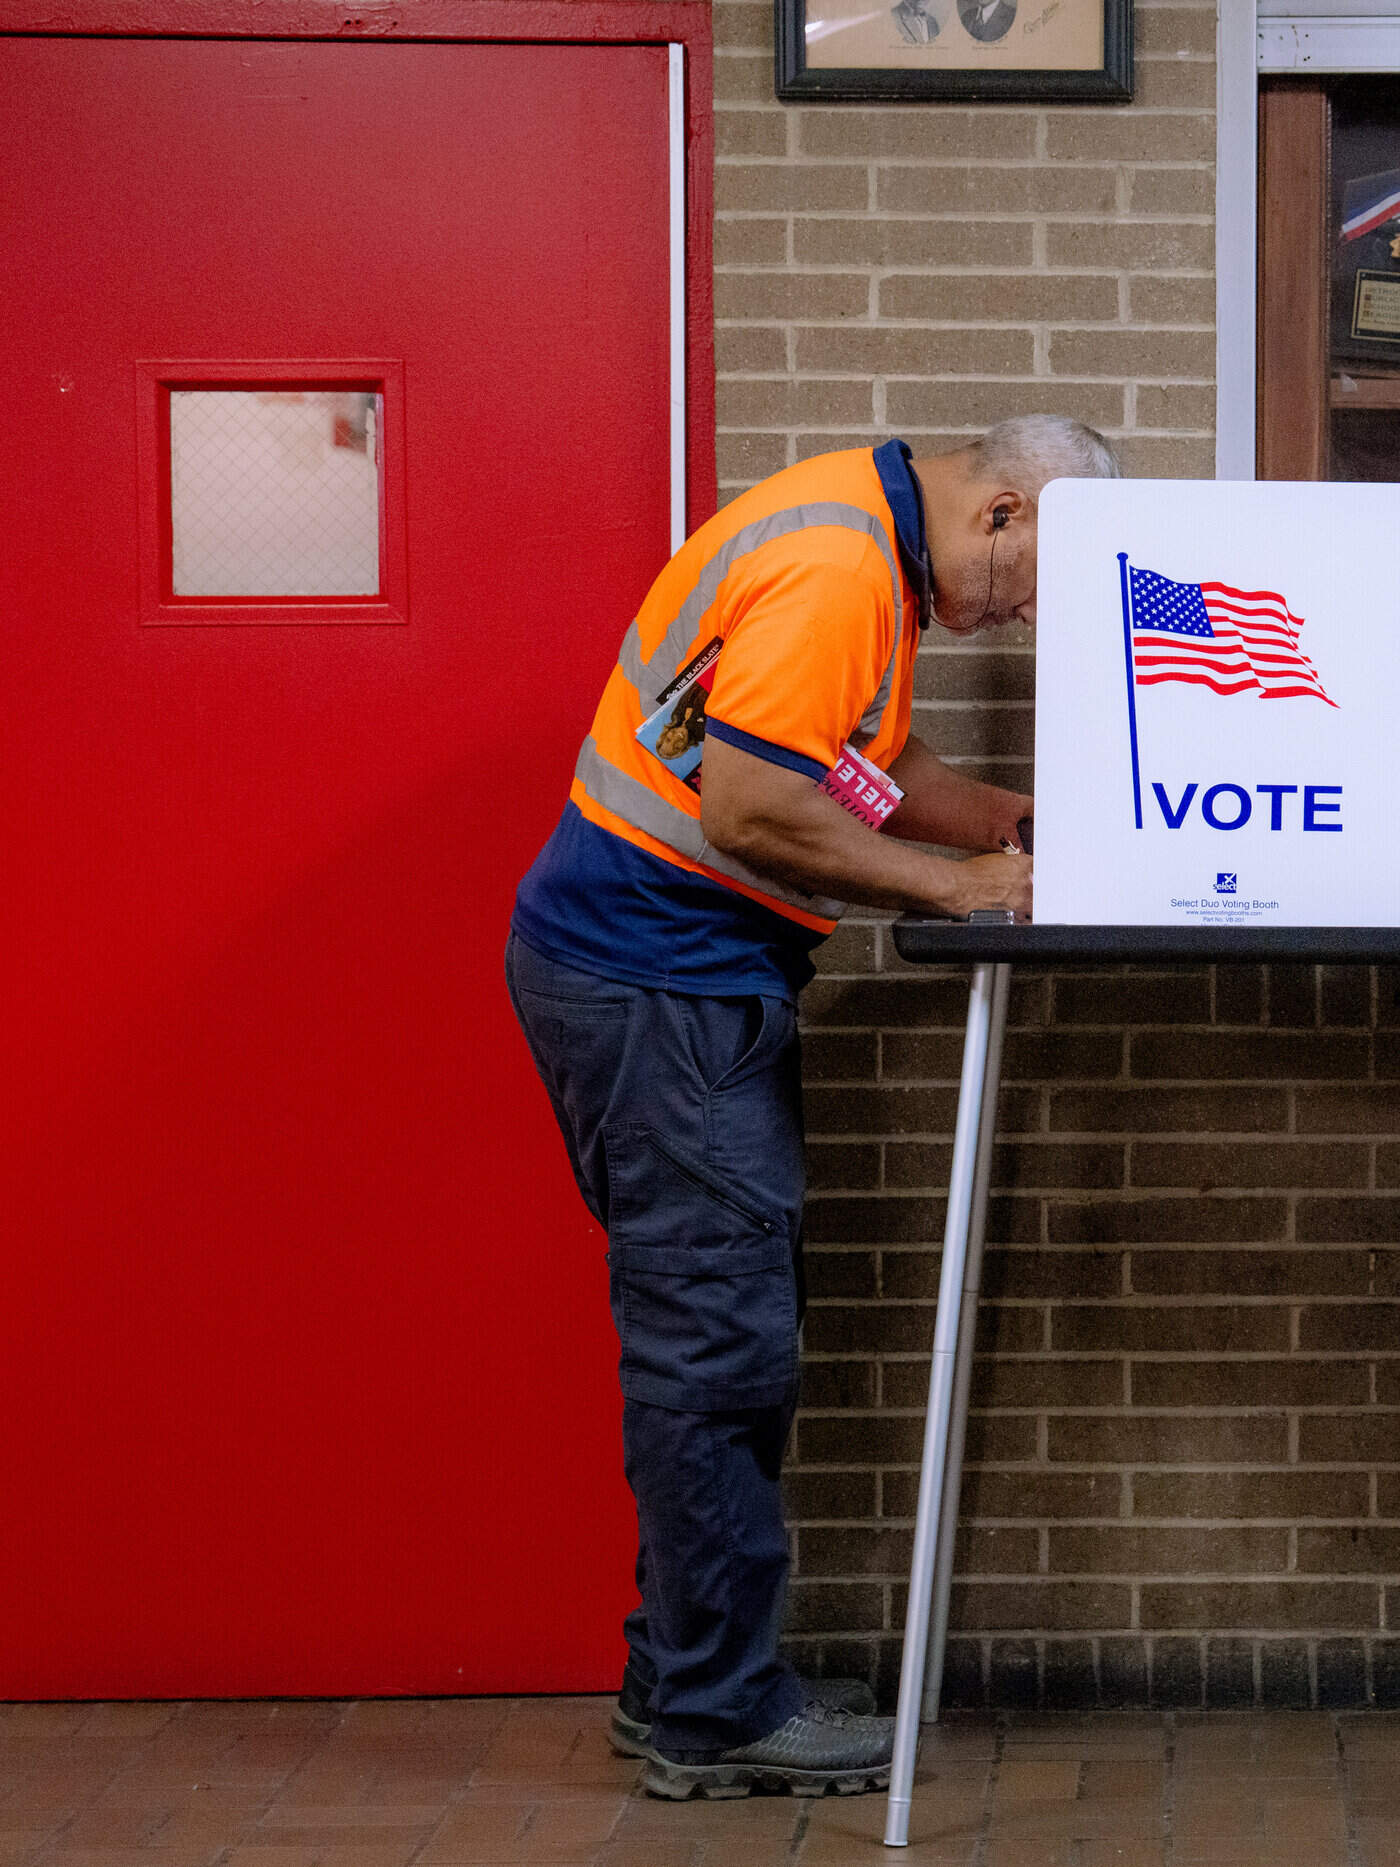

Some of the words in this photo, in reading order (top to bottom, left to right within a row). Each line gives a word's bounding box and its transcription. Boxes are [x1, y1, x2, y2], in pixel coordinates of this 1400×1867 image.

[675, 677, 689, 689] THE
[685, 661, 705, 680] BLACK
[701, 646, 720, 664] SLATE
[1151, 782, 1343, 832] VOTE
[1212, 881, 1237, 891] select
[1170, 898, 1199, 908] Select
[1200, 898, 1220, 908] Duo
[1221, 899, 1250, 910] Voting
[1252, 899, 1280, 909] Booth
[1186, 909, 1263, 917] www.selectvotingbooths.com
